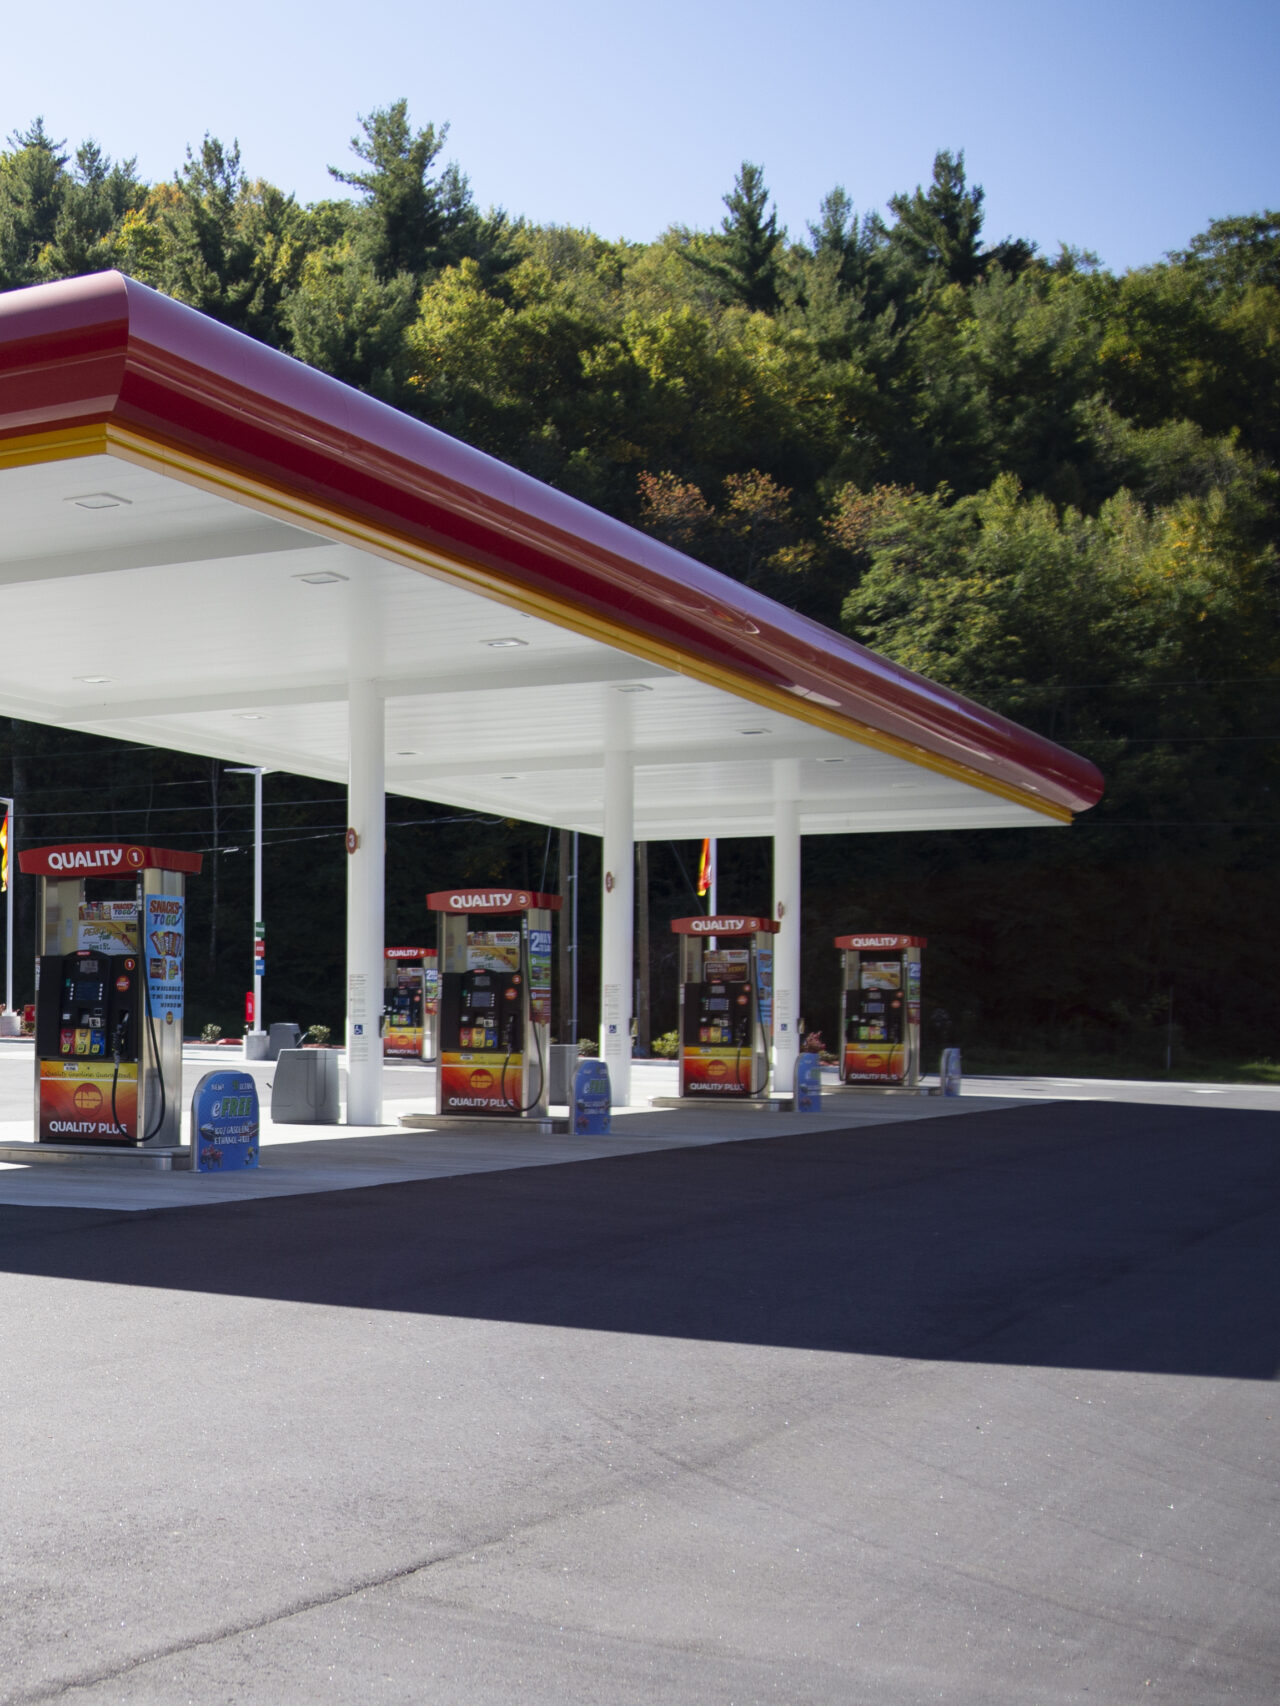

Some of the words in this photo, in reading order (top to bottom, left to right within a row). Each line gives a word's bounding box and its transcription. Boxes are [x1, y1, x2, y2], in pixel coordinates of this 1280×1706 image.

[349, 834, 354, 848] 3
[48, 849, 122, 870] QUALITY
[132, 852, 138, 862] 1
[150, 900, 179, 914] SNACKS
[450, 894, 512, 908] QUALITY
[692, 920, 744, 932] QUALITY
[530, 932, 540, 952] 2
[852, 938, 898, 947] QUALITY
[387, 949, 418, 957] QUALITY
[690, 1082, 724, 1090] QUALITY
[213, 1096, 252, 1118] eFREE
[449, 1097, 488, 1107] QUALITY
[49, 1120, 96, 1133] QUALITY
